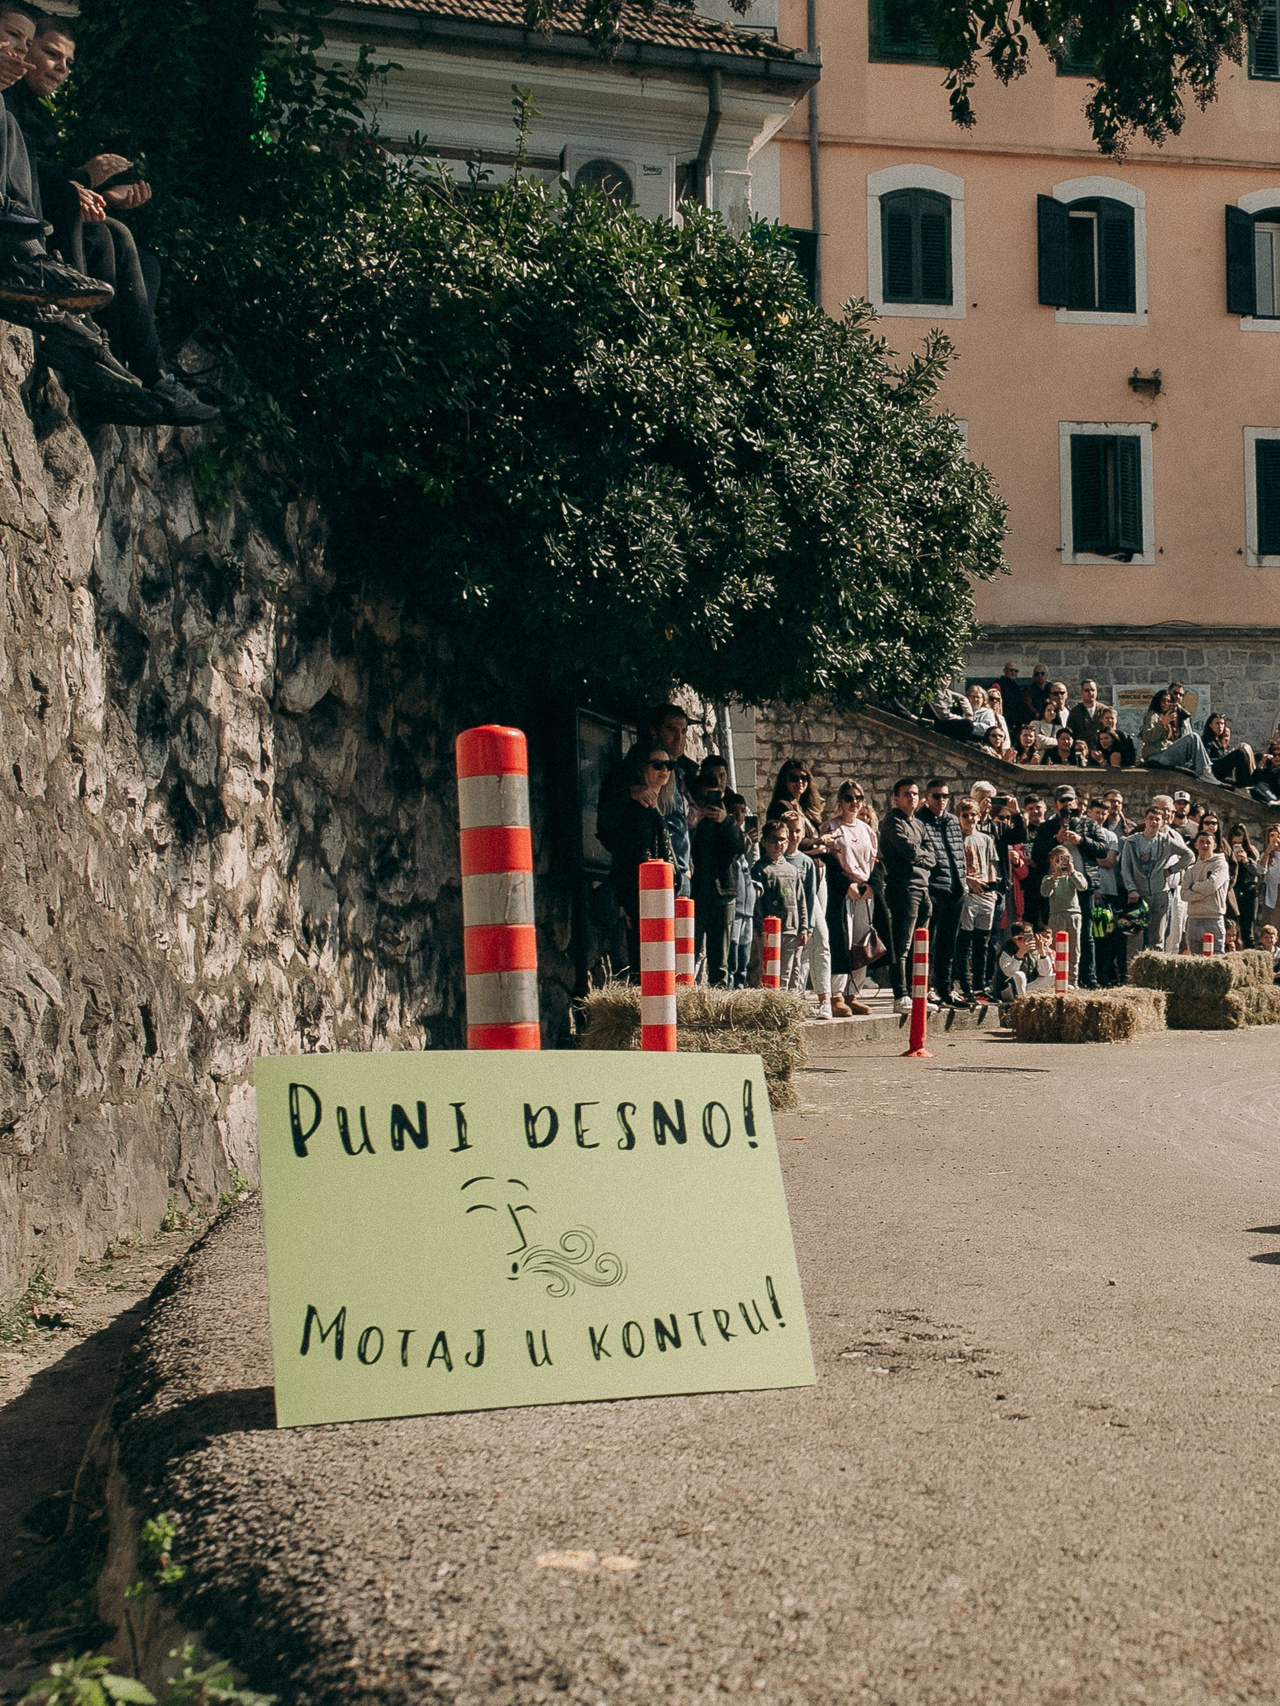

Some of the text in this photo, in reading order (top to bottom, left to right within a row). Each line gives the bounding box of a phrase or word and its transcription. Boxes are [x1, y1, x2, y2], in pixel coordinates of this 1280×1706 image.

[289, 1079, 759, 1158] PUNI DESNO!
[300, 1303, 486, 1372] MOTAJ
[588, 1275, 787, 1361] KONTRU!
